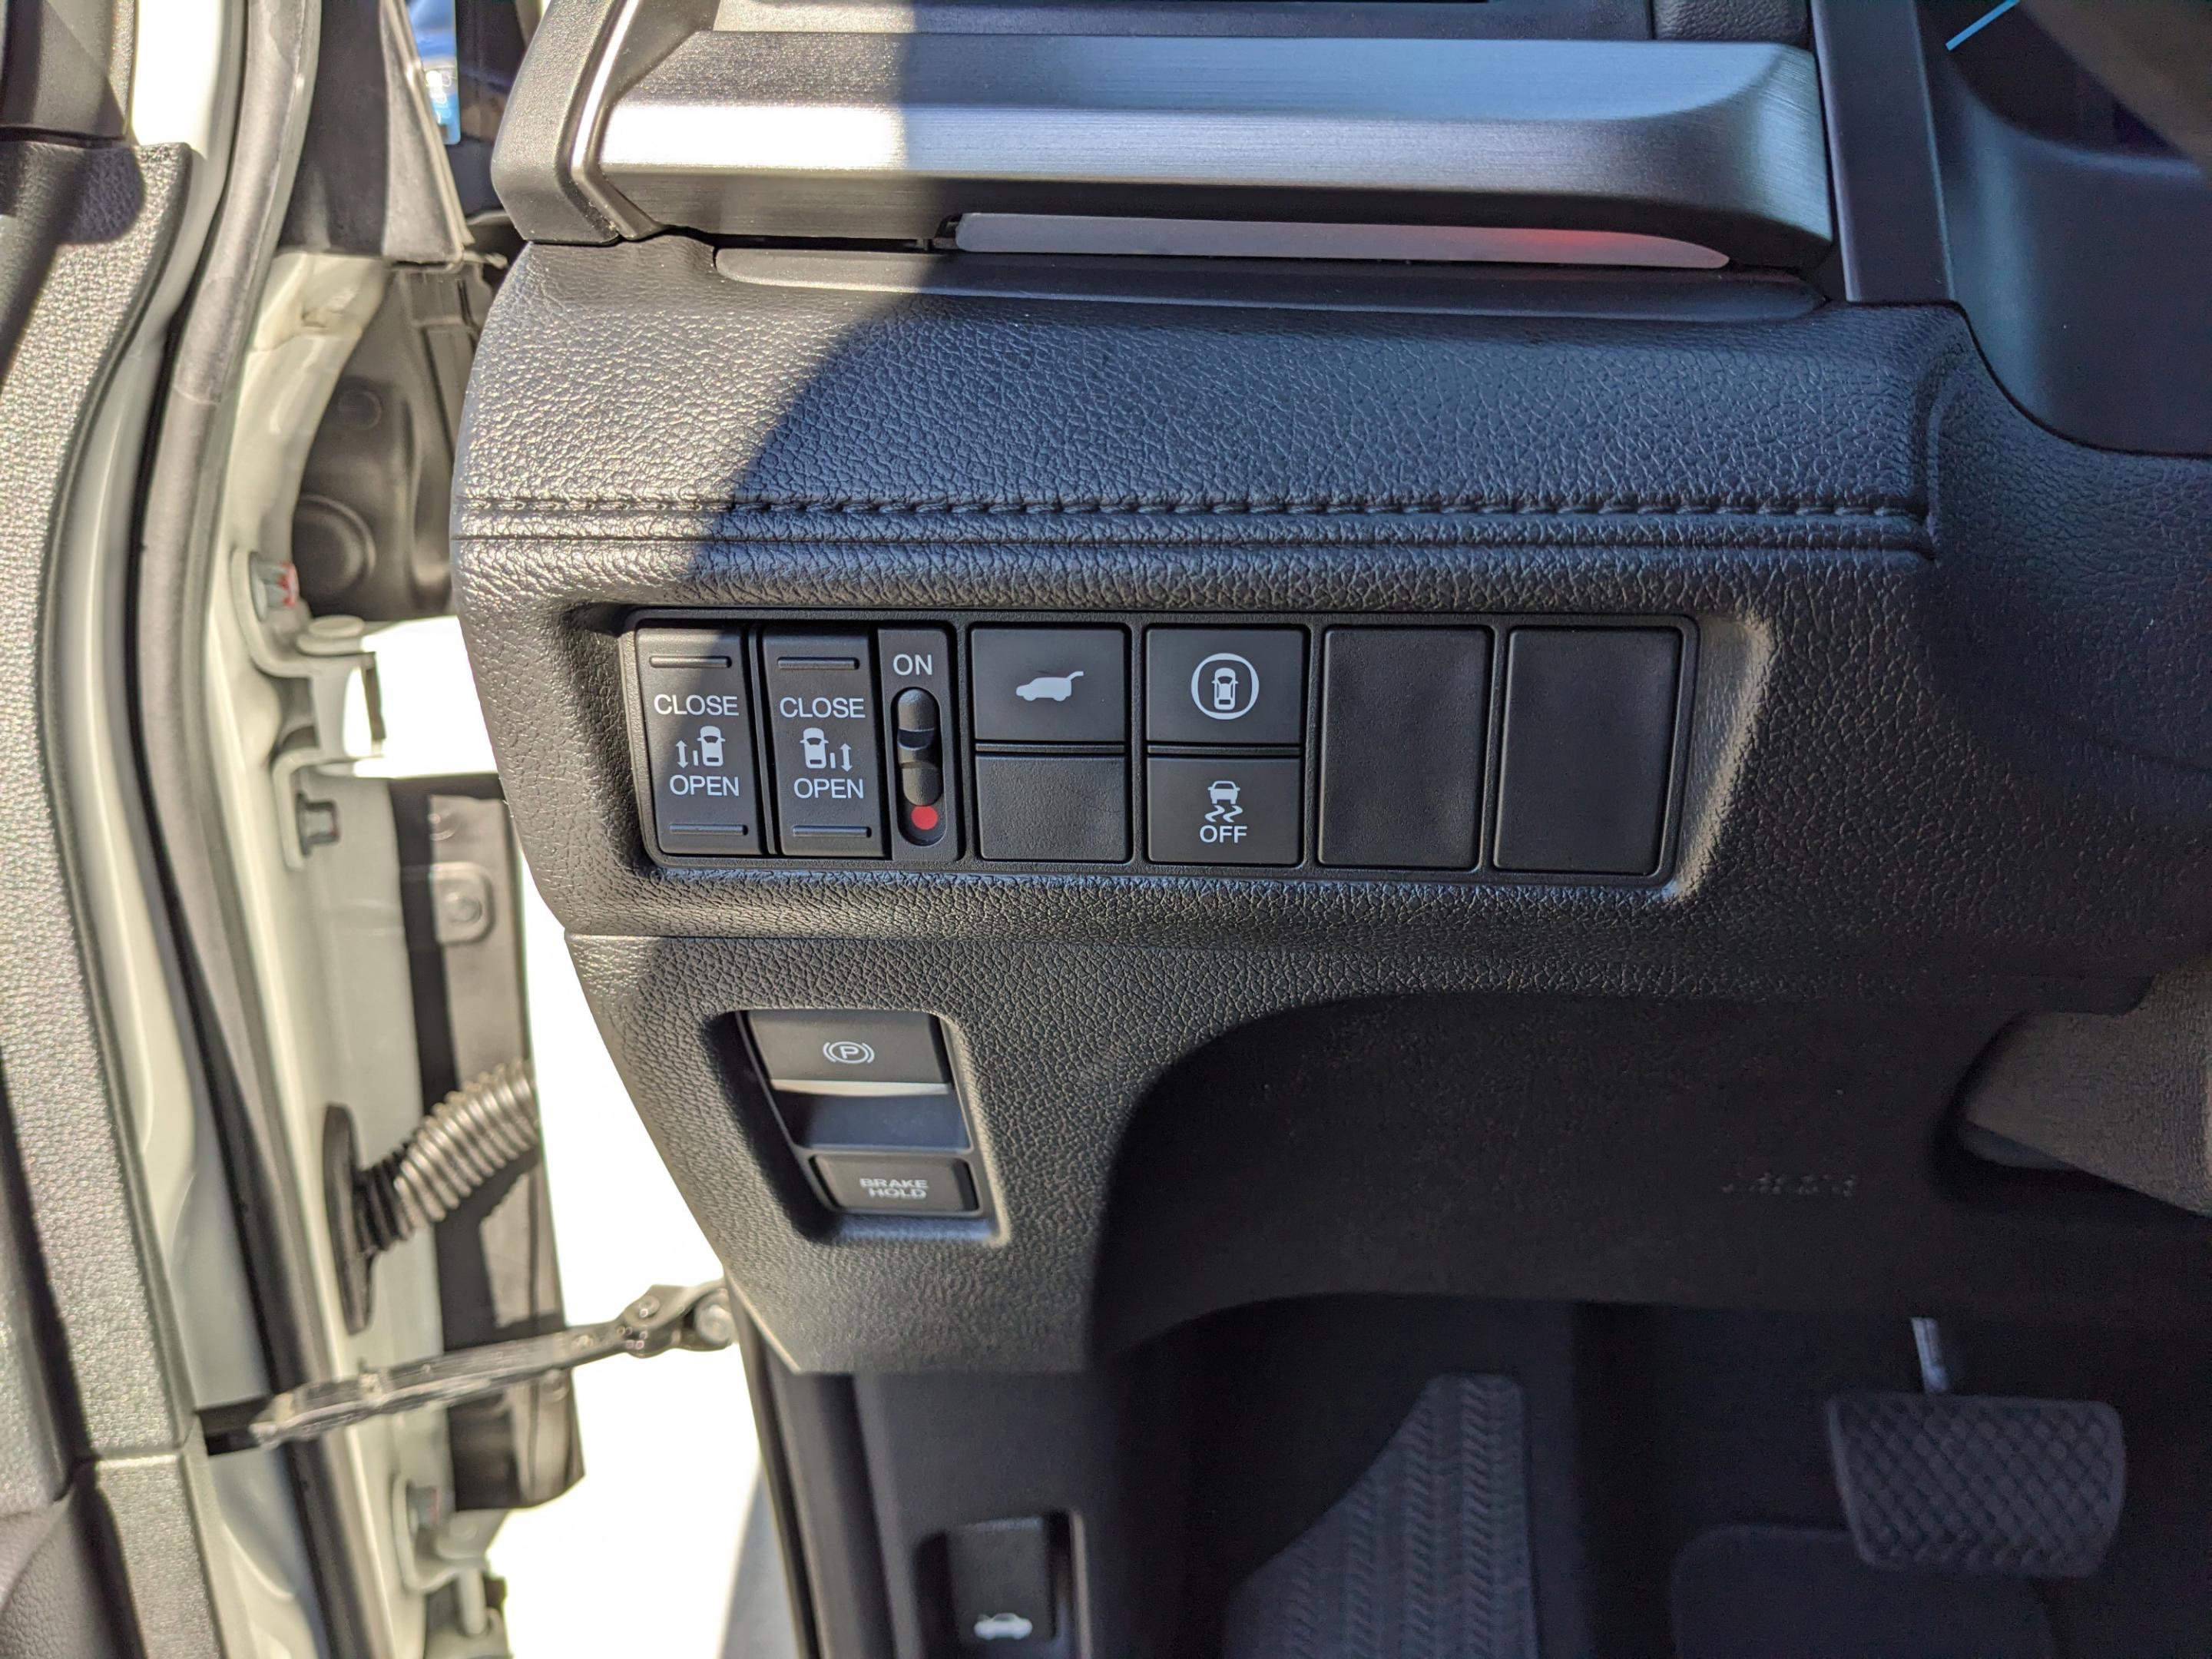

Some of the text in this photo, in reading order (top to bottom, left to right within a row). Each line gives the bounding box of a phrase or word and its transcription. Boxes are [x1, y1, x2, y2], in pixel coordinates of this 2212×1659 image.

[892, 654, 932, 676] ON
[654, 694, 740, 717] CLOSE
[779, 697, 866, 719] CLOSE
[670, 774, 740, 796] OPEN
[793, 777, 864, 799] OPEN
[1199, 825, 1248, 843] OFF
[859, 1177, 929, 1188] BRAKE
[869, 1187, 927, 1199] HOLD
